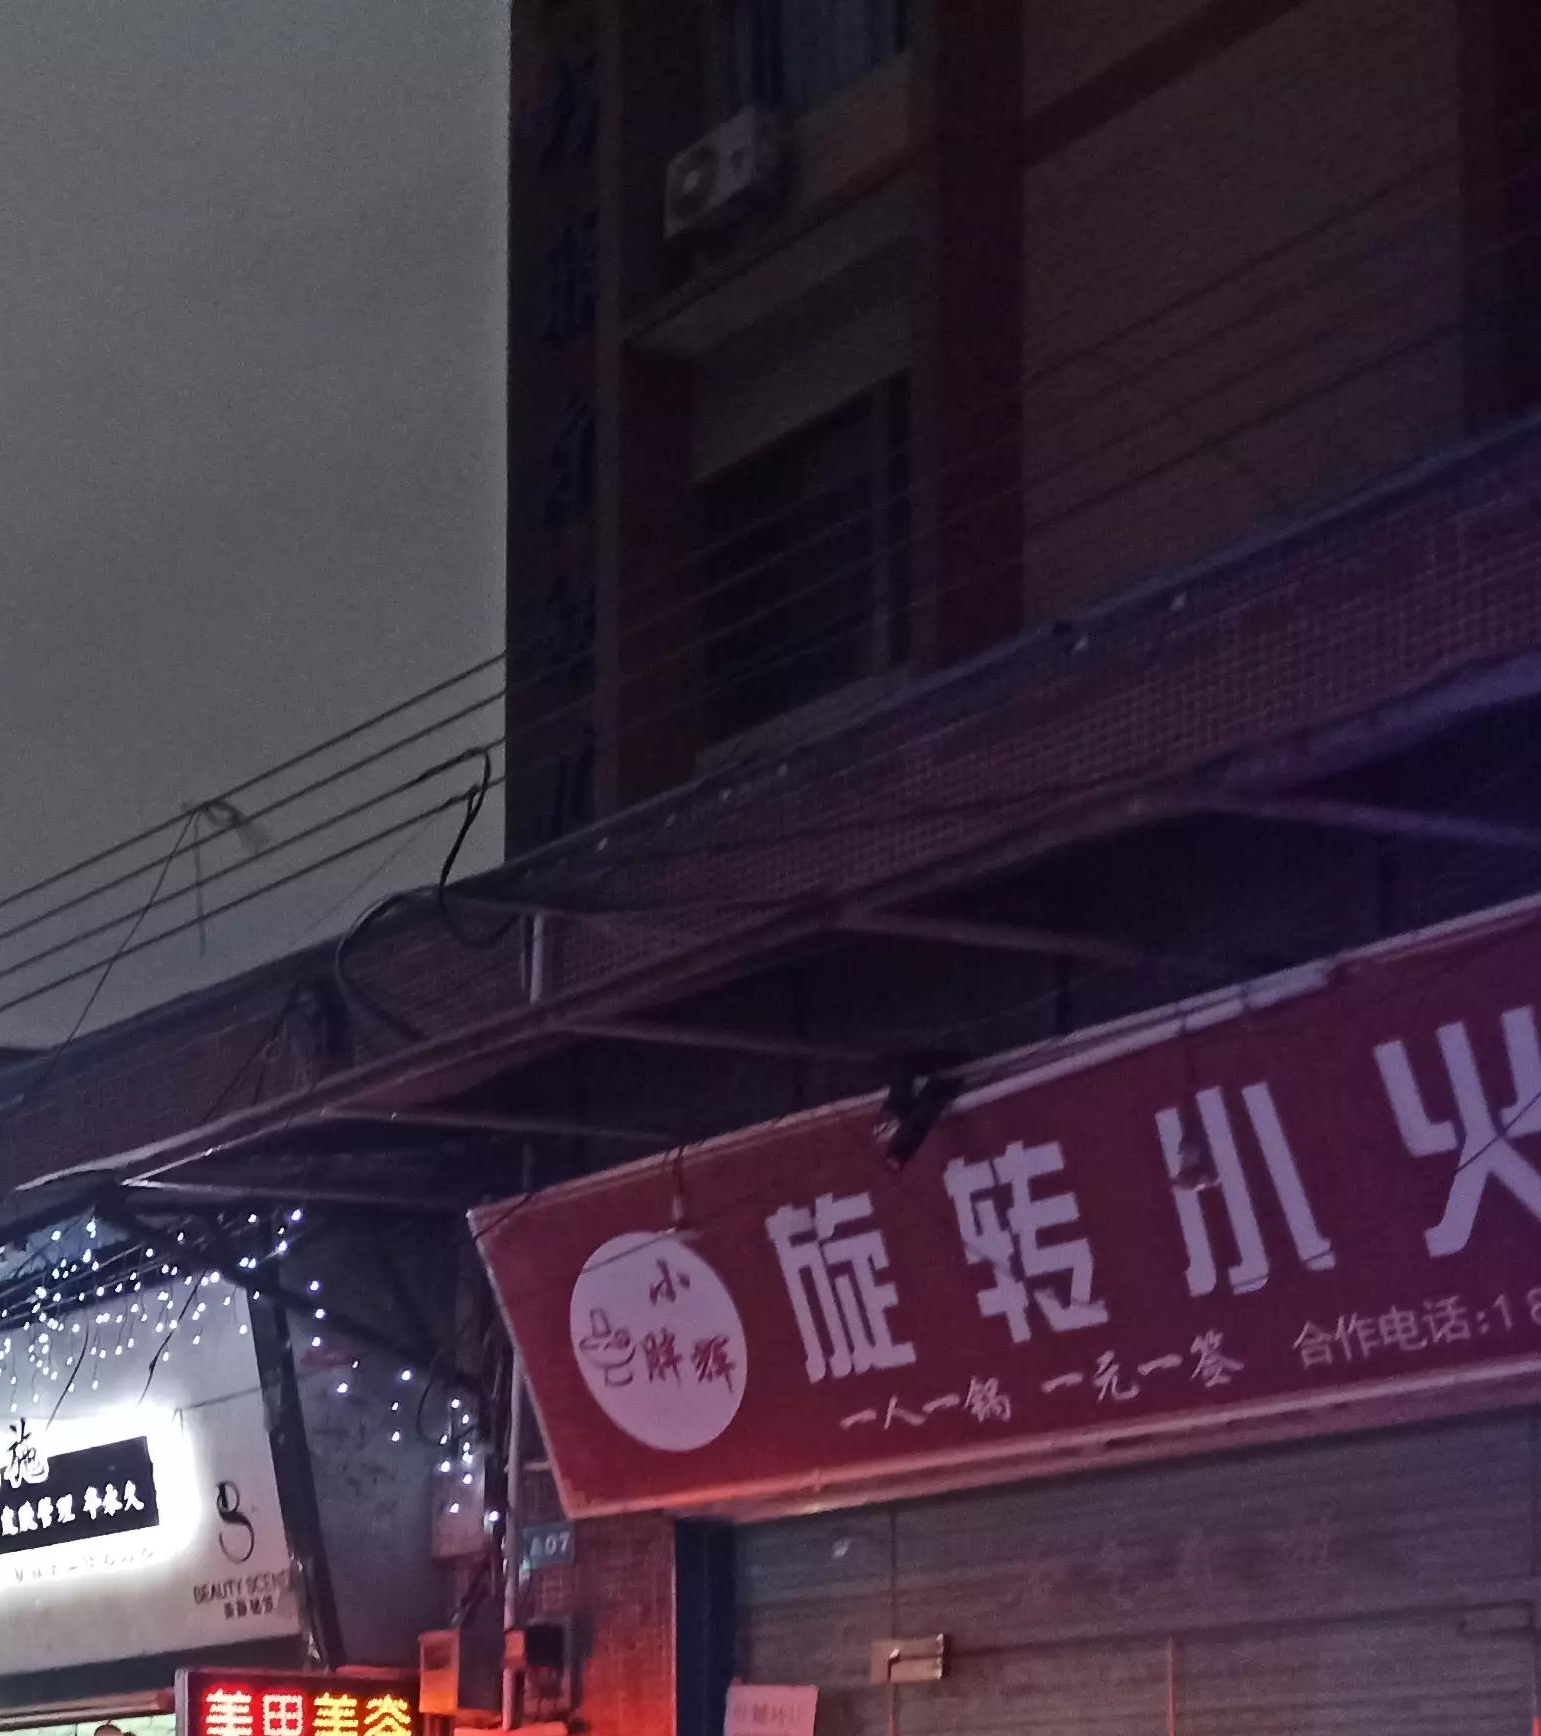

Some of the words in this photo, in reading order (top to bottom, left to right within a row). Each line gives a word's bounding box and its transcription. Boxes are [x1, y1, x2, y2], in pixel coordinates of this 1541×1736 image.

[839, 1374, 1013, 1431] 一人一锅
[1041, 1328, 1245, 1404] 一元一签
